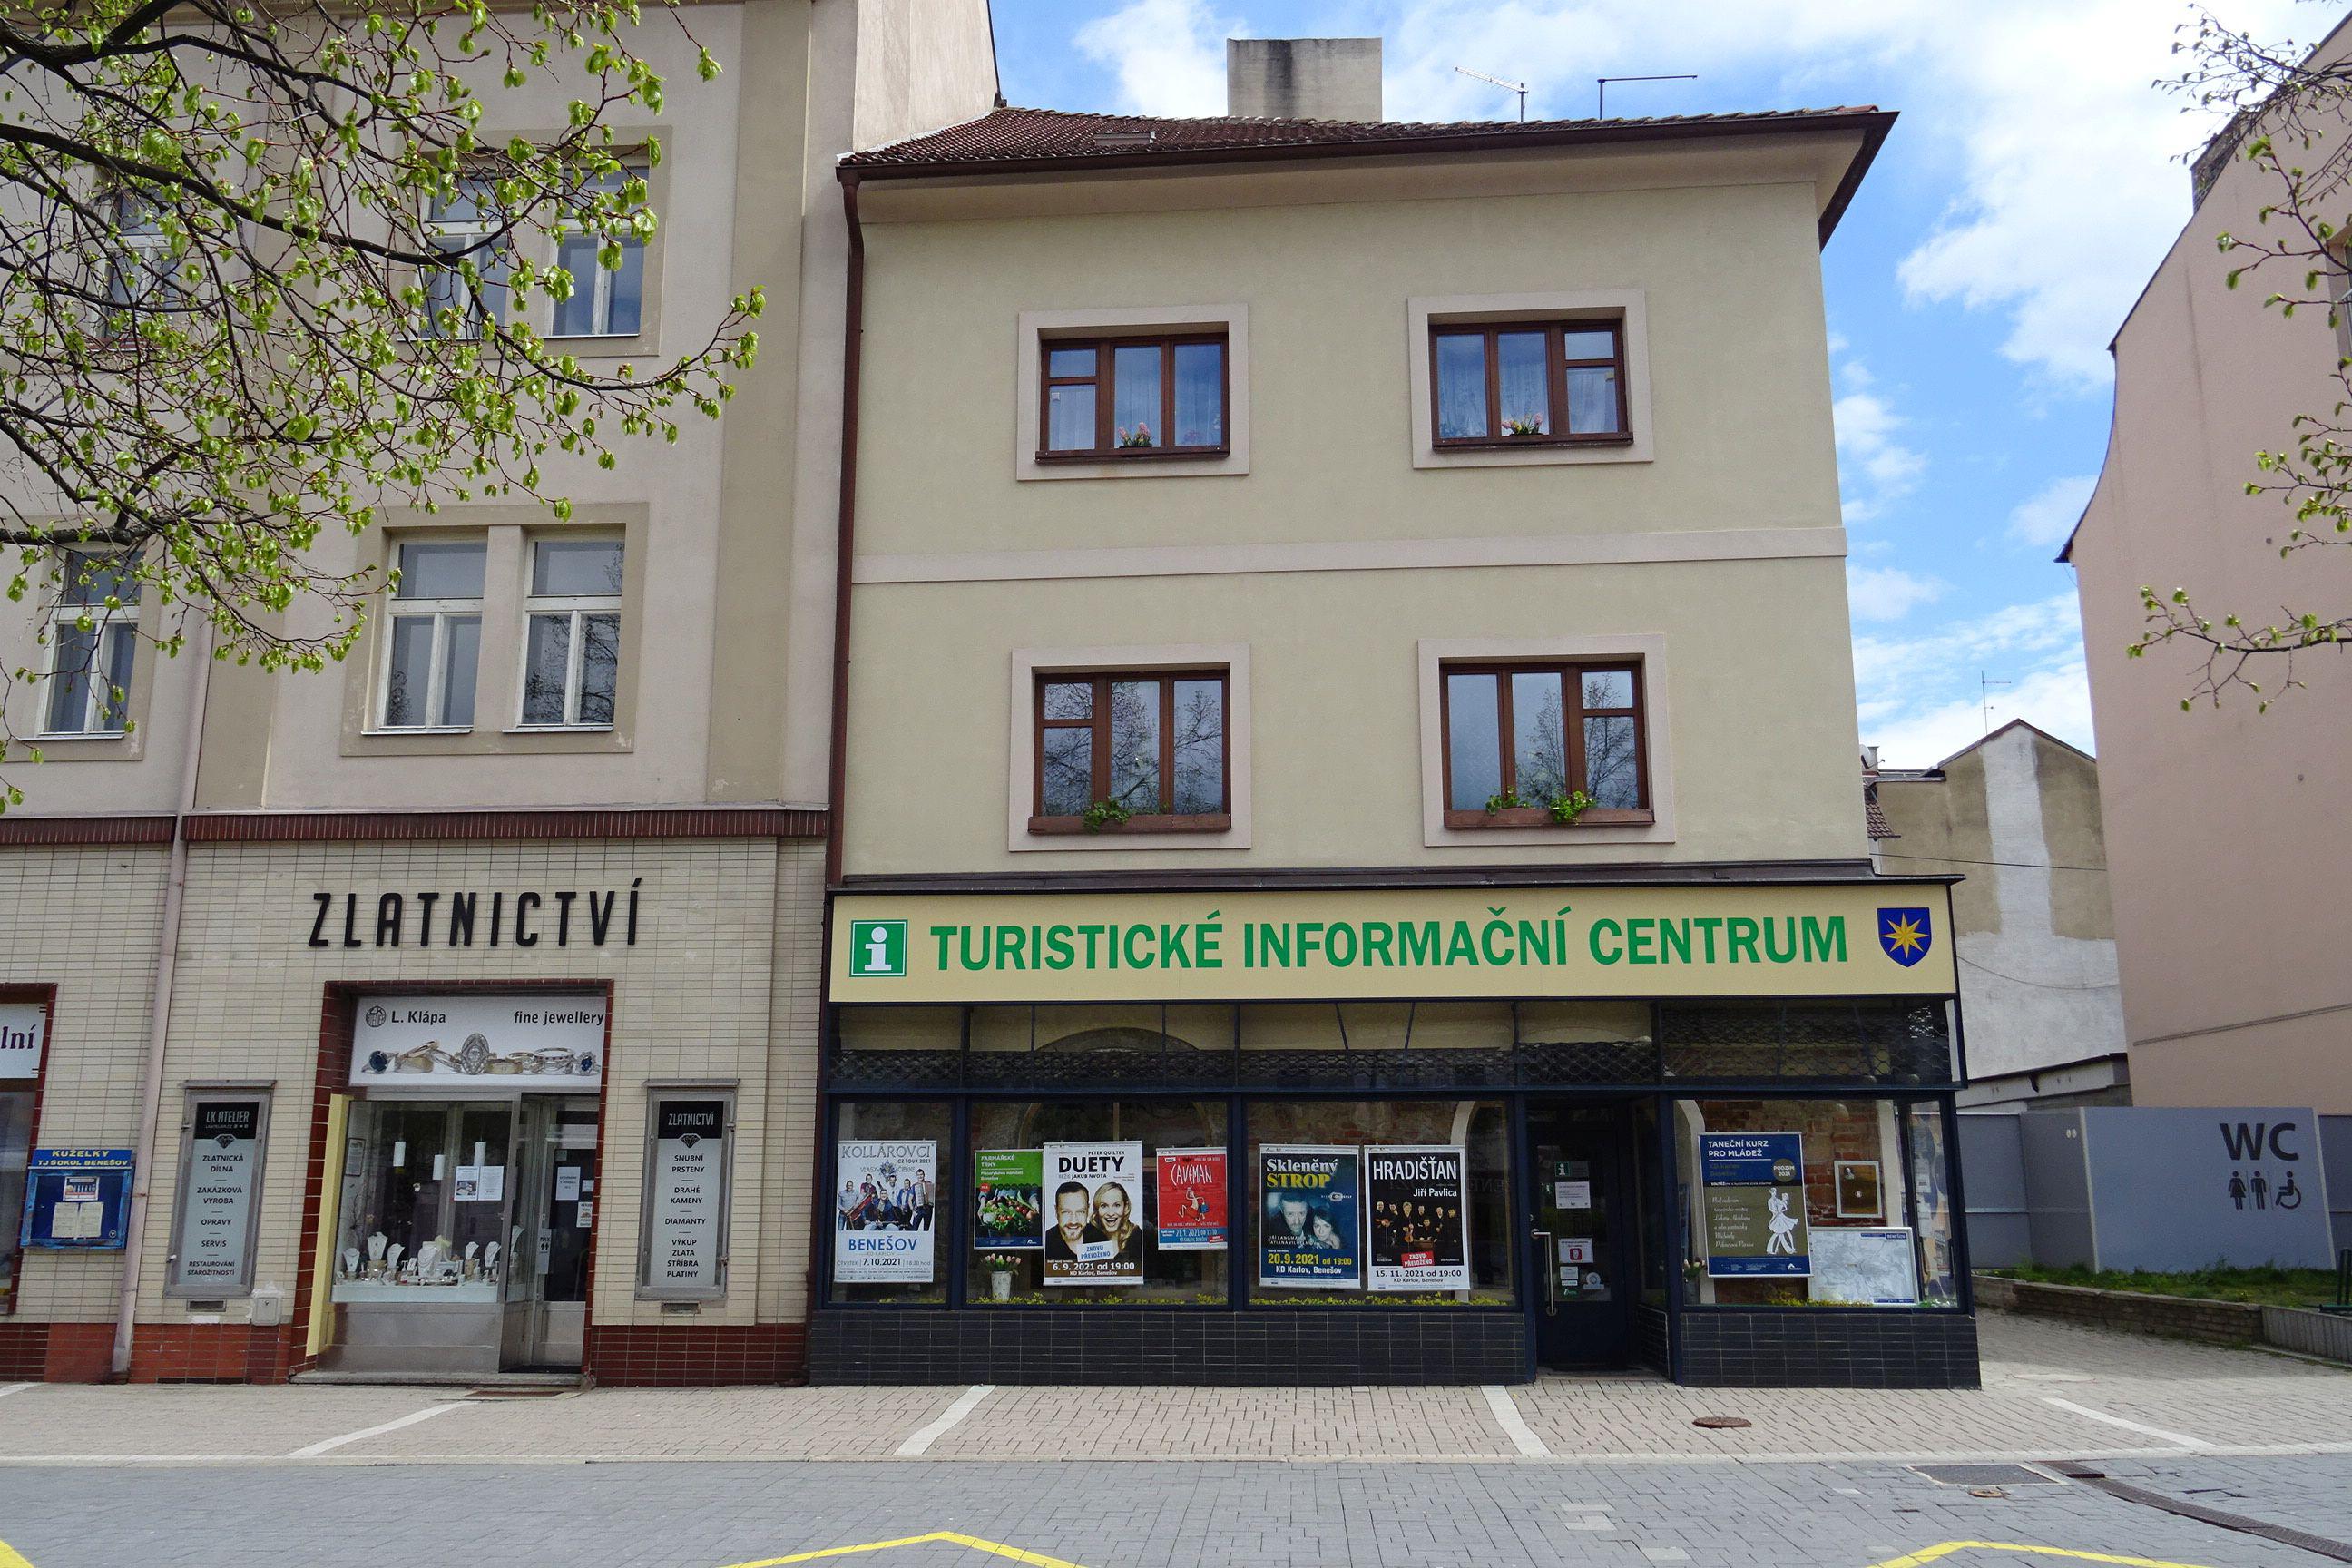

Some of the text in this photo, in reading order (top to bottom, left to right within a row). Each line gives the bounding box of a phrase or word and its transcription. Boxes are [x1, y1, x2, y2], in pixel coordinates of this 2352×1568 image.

[308, 877, 642, 947] ZLATNICTVÍ
[930, 909, 1224, 971] TURISTICKÉ
[1244, 906, 1572, 968] INFORMAČNÍ
[1589, 916, 1847, 965] CENTRUM
[391, 1010, 446, 1026] L. Klápa
[514, 1010, 604, 1027] fine jewellery
[206, 1110, 250, 1123] LK ATELIER
[668, 1111, 715, 1126] ZLATNICTVÍ
[1708, 1139, 1745, 1148] TANEČNÍ
[2220, 1122, 2298, 1161] WC
[201, 1153, 244, 1162] ZLATNICKÁ
[841, 1142, 931, 1159] KOLLÁROVCI
[1728, 1148, 1763, 1157] MLÁDEŽ
[671, 1165, 705, 1173] PRSTENY
[1058, 1156, 1125, 1173] DUETY
[1266, 1158, 1338, 1174] Skleněný
[1373, 1156, 1457, 1181] HRADIŠŤAN
[1171, 1163, 1213, 1186] CAVEMAN
[1266, 1173, 1331, 1189] STROP
[674, 1185, 701, 1193] DRAHÉ
[1413, 1188, 1457, 1197] Jiří Pavlica
[848, 1235, 918, 1251] BENEŠOV
[667, 1259, 699, 1267] STŘÍBRA
[863, 1258, 901, 1266] 7.10.2021
[1097, 1262, 1108, 1270] od
[1110, 1262, 1135, 1270] 19:00
[1322, 1257, 1331, 1265] od
[1333, 1258, 1352, 1266] 19:00
[1276, 1265, 1342, 1274] KD Karlov, Benešov
